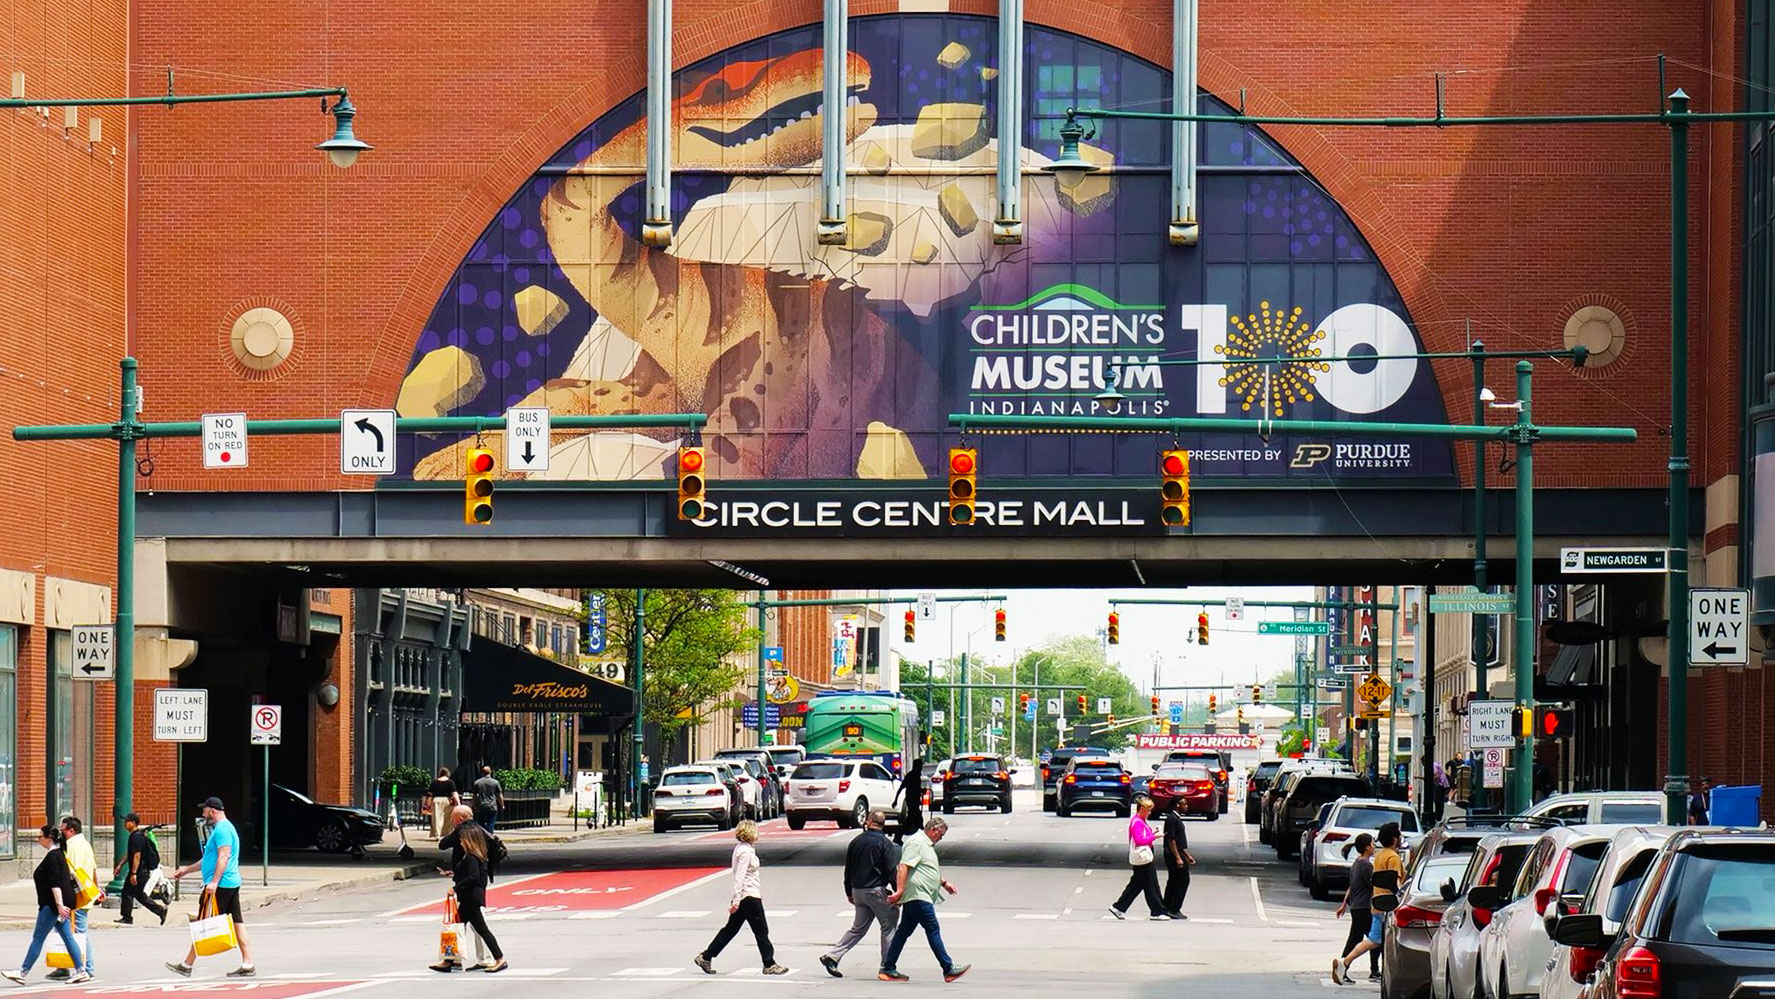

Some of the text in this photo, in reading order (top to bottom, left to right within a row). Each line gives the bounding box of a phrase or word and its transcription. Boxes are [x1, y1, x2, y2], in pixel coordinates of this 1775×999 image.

[970, 314, 1165, 345] CHILDREN'S
[971, 355, 1164, 390] MUSEUM
[519, 412, 538, 423] BUS
[215, 418, 234, 428] NO
[213, 431, 238, 440] TURN
[515, 427, 541, 437] ONLY
[207, 441, 243, 450] ON RED
[1188, 449, 1282, 461] PRESENTED BY
[1336, 444, 1410, 459] PURDUE
[351, 455, 386, 468] ONLY
[1336, 459, 1411, 468] UNIVERSITY
[852, 501, 1024, 527] CENRE
[1033, 501, 1145, 526] MALL
[1586, 555, 1647, 565] NEWGARDEN
[1444, 602, 1497, 611] ILLINOIS
[1699, 598, 1741, 614] ONE
[1279, 624, 1315, 633] Meridian
[1697, 621, 1742, 638] WAY
[78, 631, 109, 644] ONE
[77, 648, 110, 660] WAY
[512, 682, 588, 699] Del Frisco's
[160, 696, 204, 705] LEFT LANE
[166, 710, 194, 720] MUST
[1472, 707, 1513, 715] RIGHT LANE
[1480, 720, 1505, 729] MUST
[157, 725, 203, 735] TURN LEFT
[847, 726, 859, 735] 90
[1140, 736, 1252, 748] PUBLIC PARKING
[1472, 734, 1491, 742] TURN
[511, 886, 634, 896] ONLY
